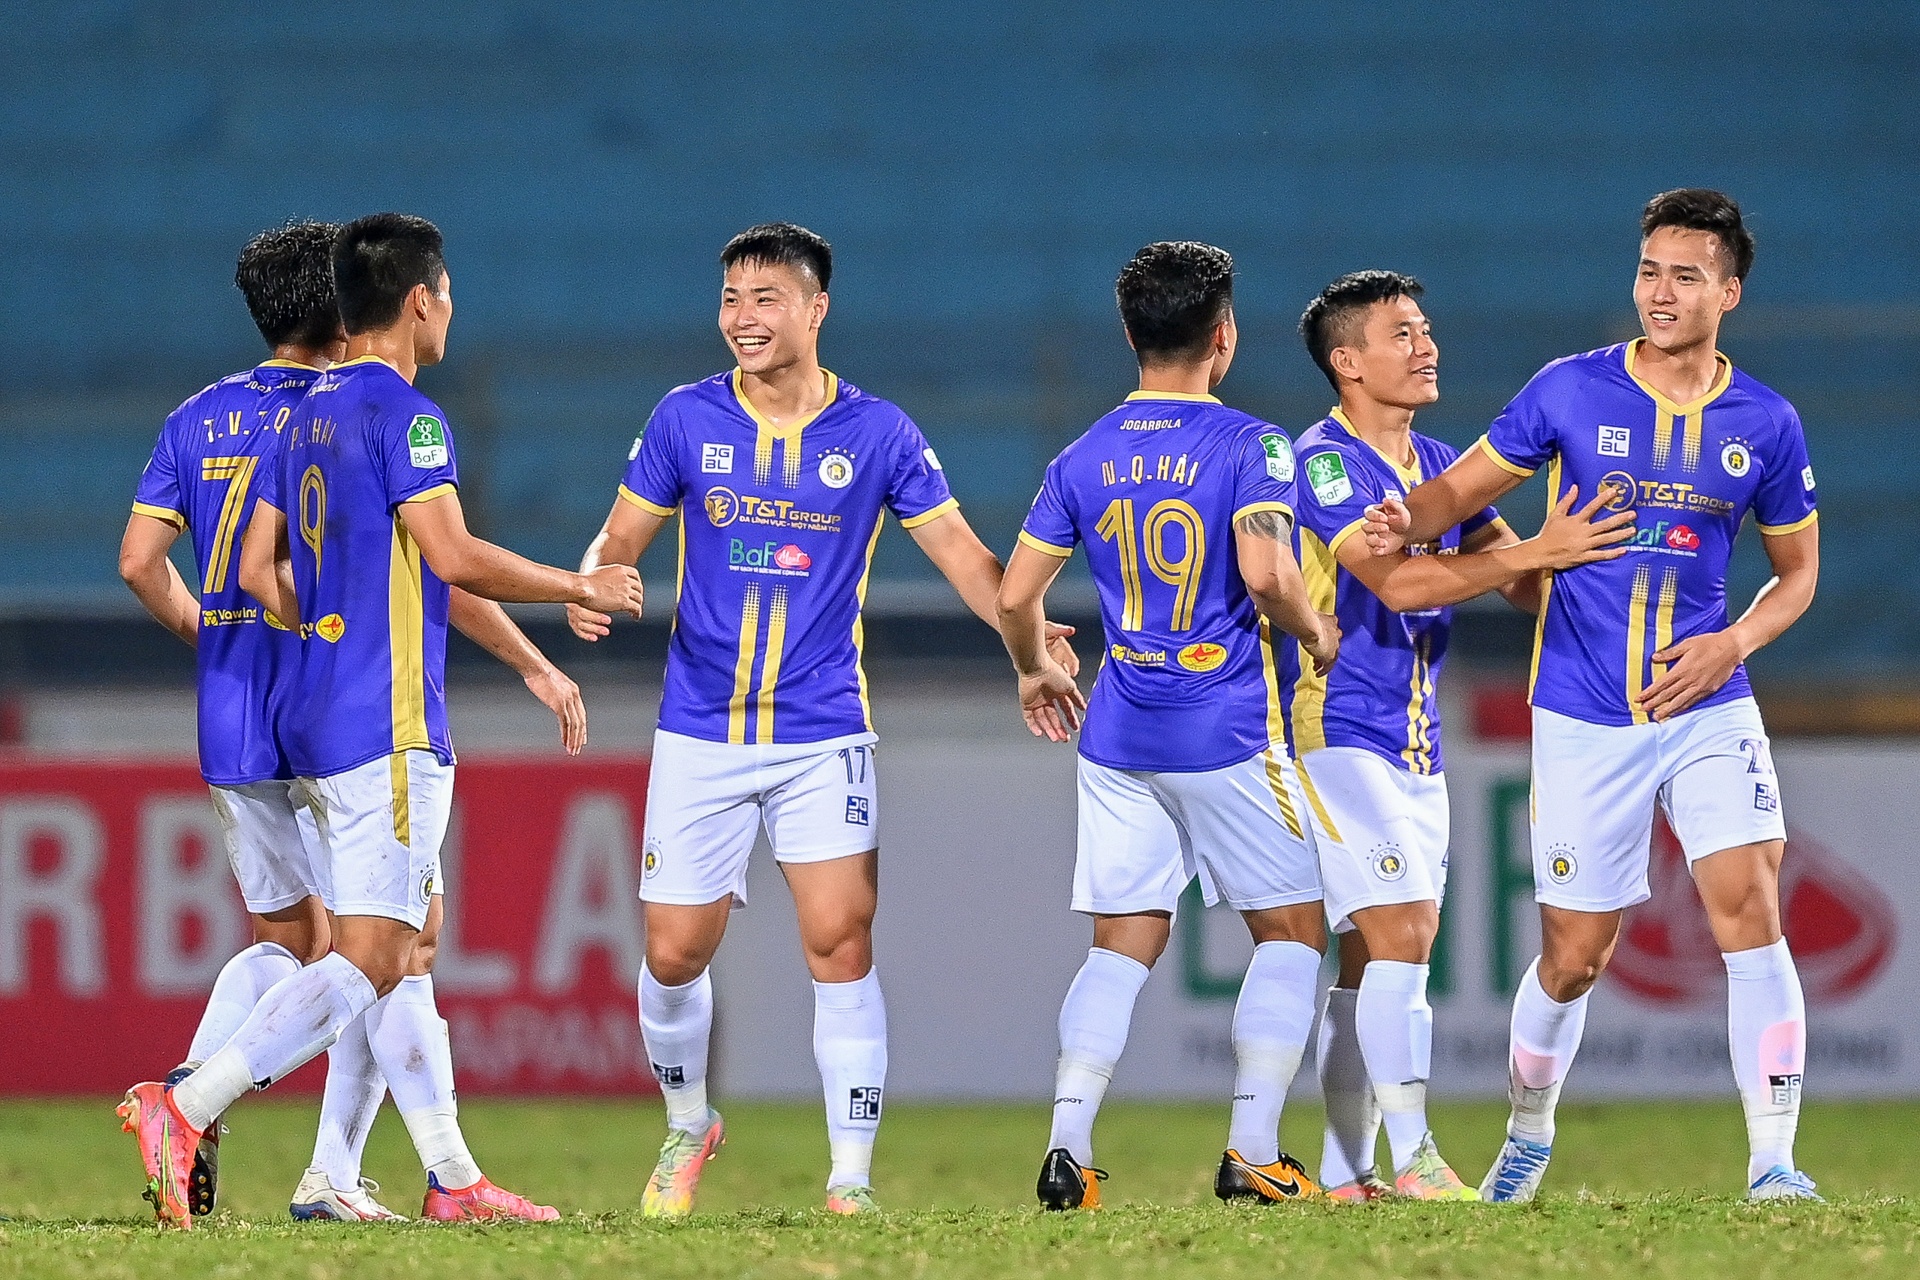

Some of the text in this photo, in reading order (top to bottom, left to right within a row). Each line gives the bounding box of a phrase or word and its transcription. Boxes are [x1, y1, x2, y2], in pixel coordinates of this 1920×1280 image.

[1120, 418, 1181, 431] JOGARBOLA
[414, 449, 438, 464] BaF
[1639, 481, 1694, 502] T&T
[202, 456, 259, 594] 7
[741, 496, 842, 525] T&T GROUP
[299, 464, 327, 587] 9
[729, 538, 778, 567] BaF
[1094, 499, 1206, 632] 19
[838, 745, 866, 784] 17
[0, 793, 645, 1002] RBLA
[851, 1088, 879, 1102] JG
[851, 1102, 878, 1118] BL
